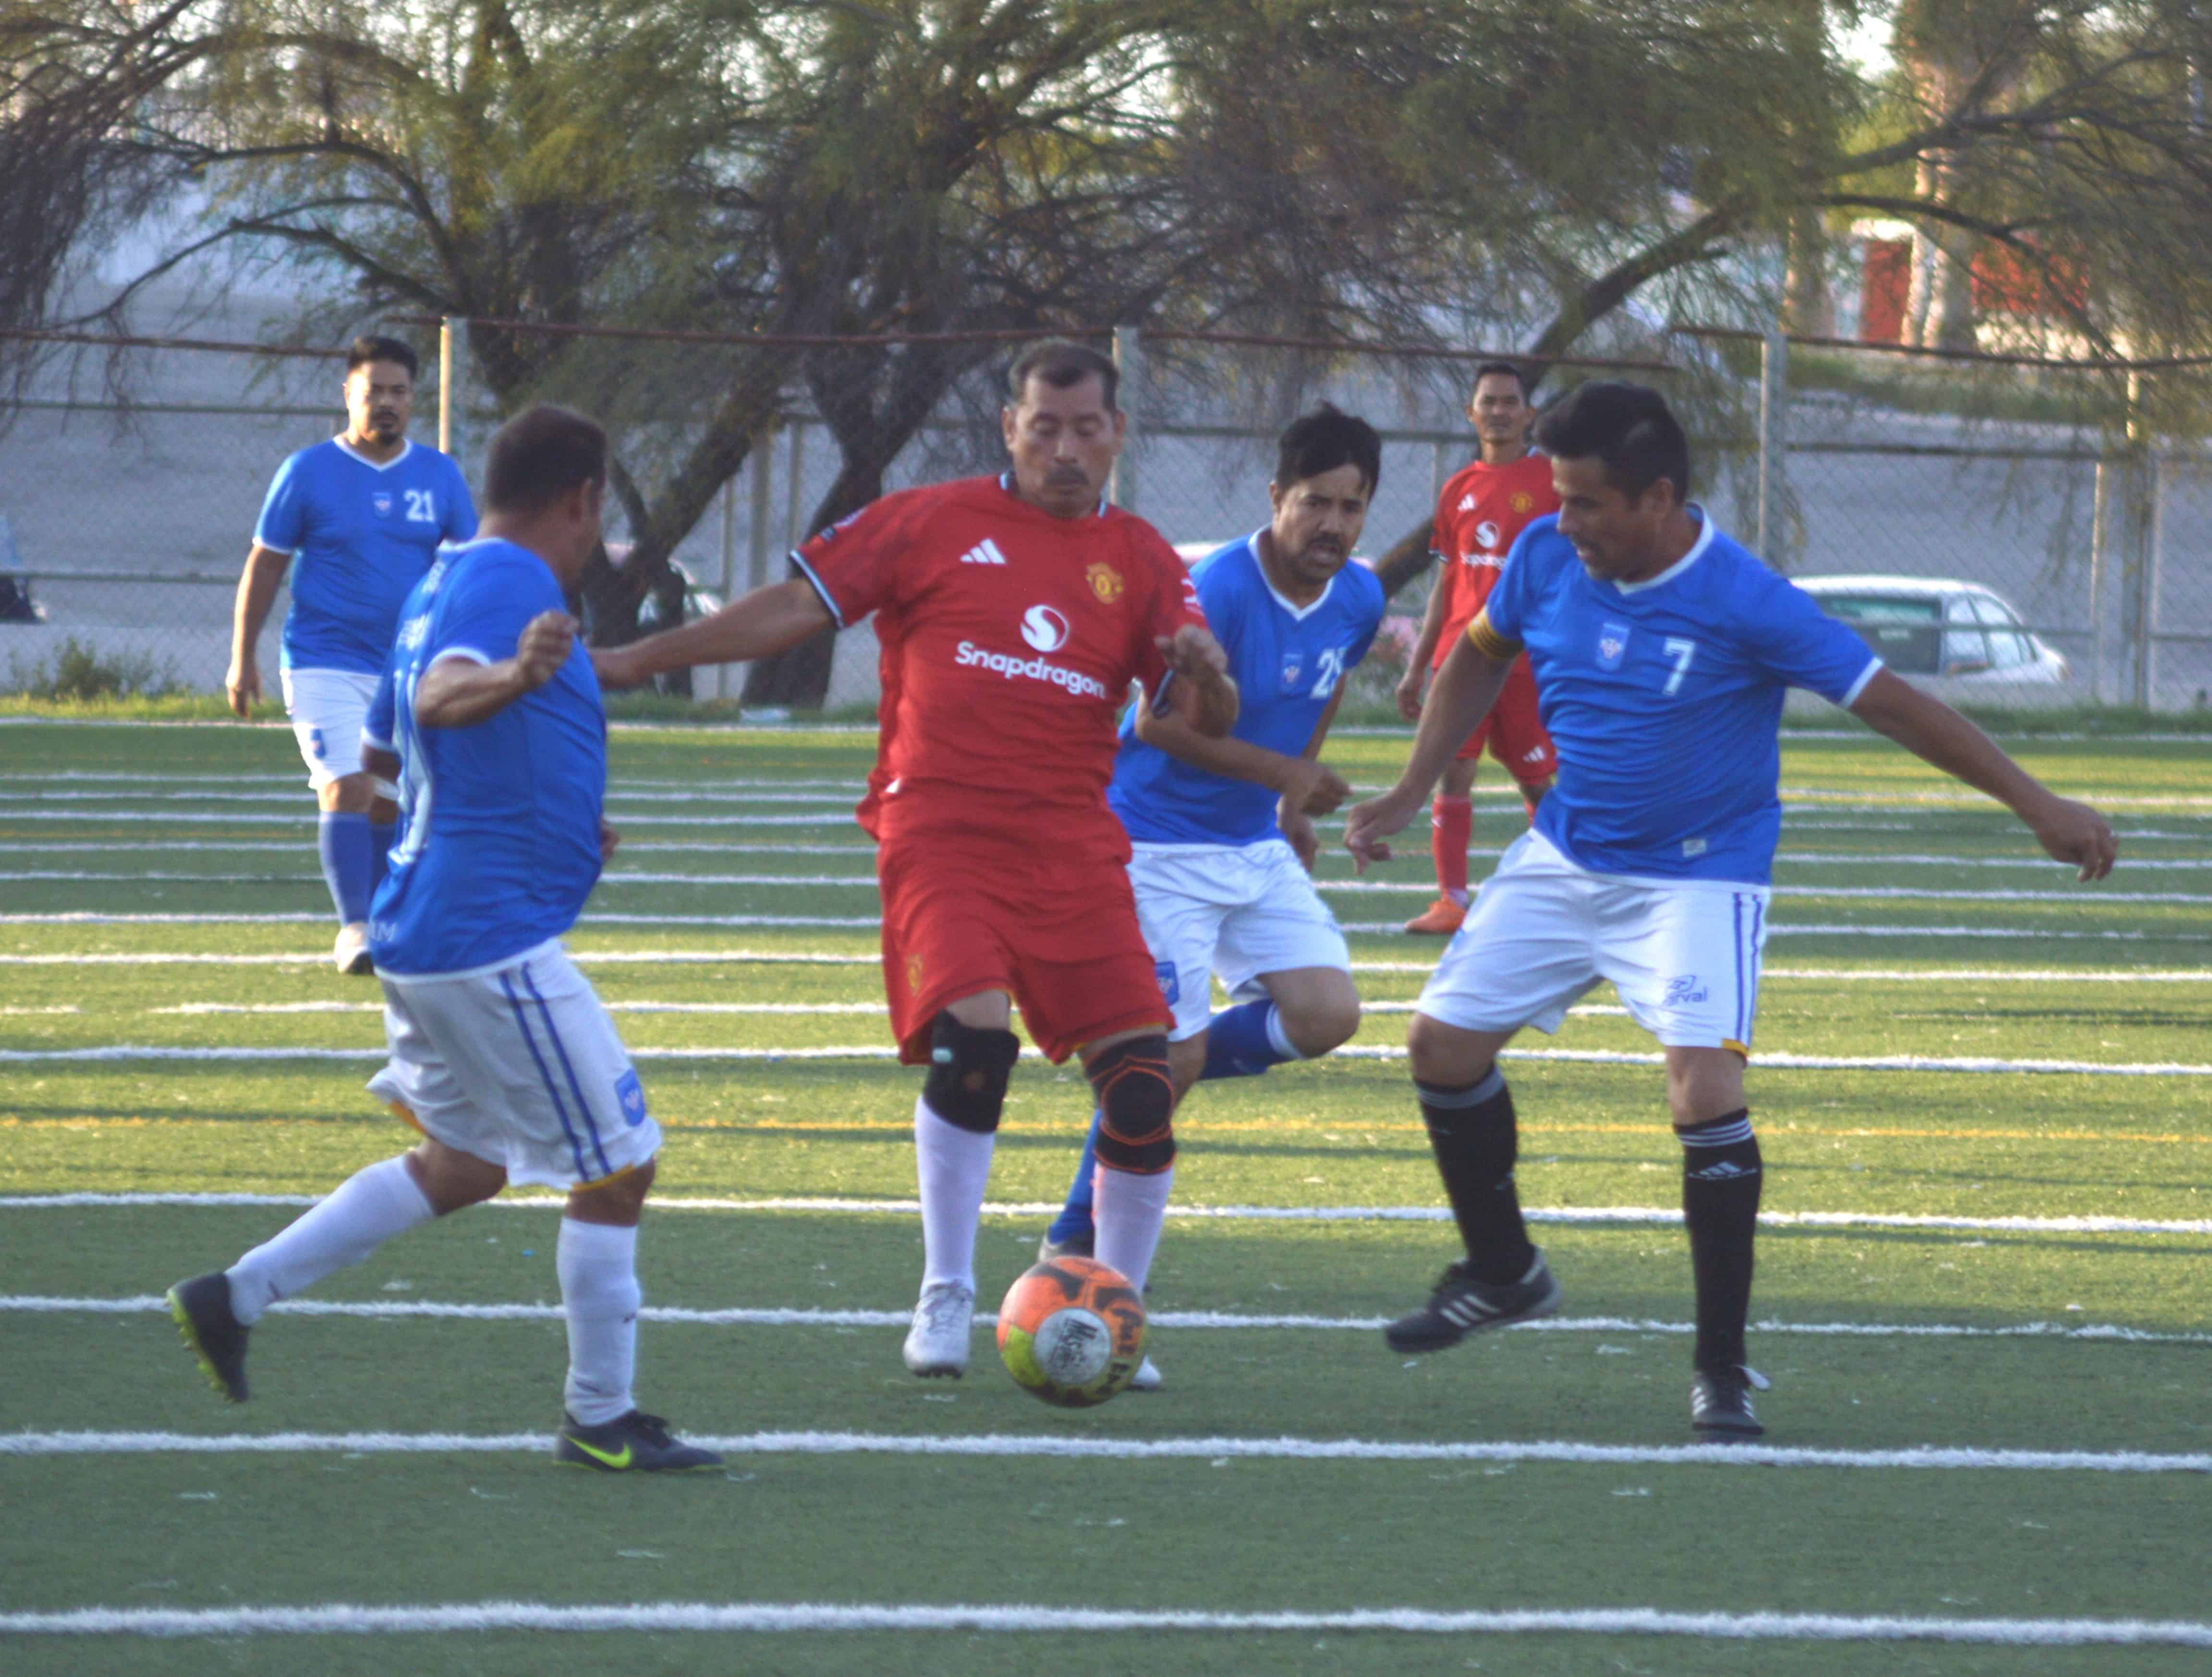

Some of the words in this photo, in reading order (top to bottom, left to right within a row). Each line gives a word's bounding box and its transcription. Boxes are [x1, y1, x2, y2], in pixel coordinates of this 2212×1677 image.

[403, 489, 435, 523] 21
[955, 640, 1106, 700] Snapdragon
[1662, 637, 1695, 696] 7
